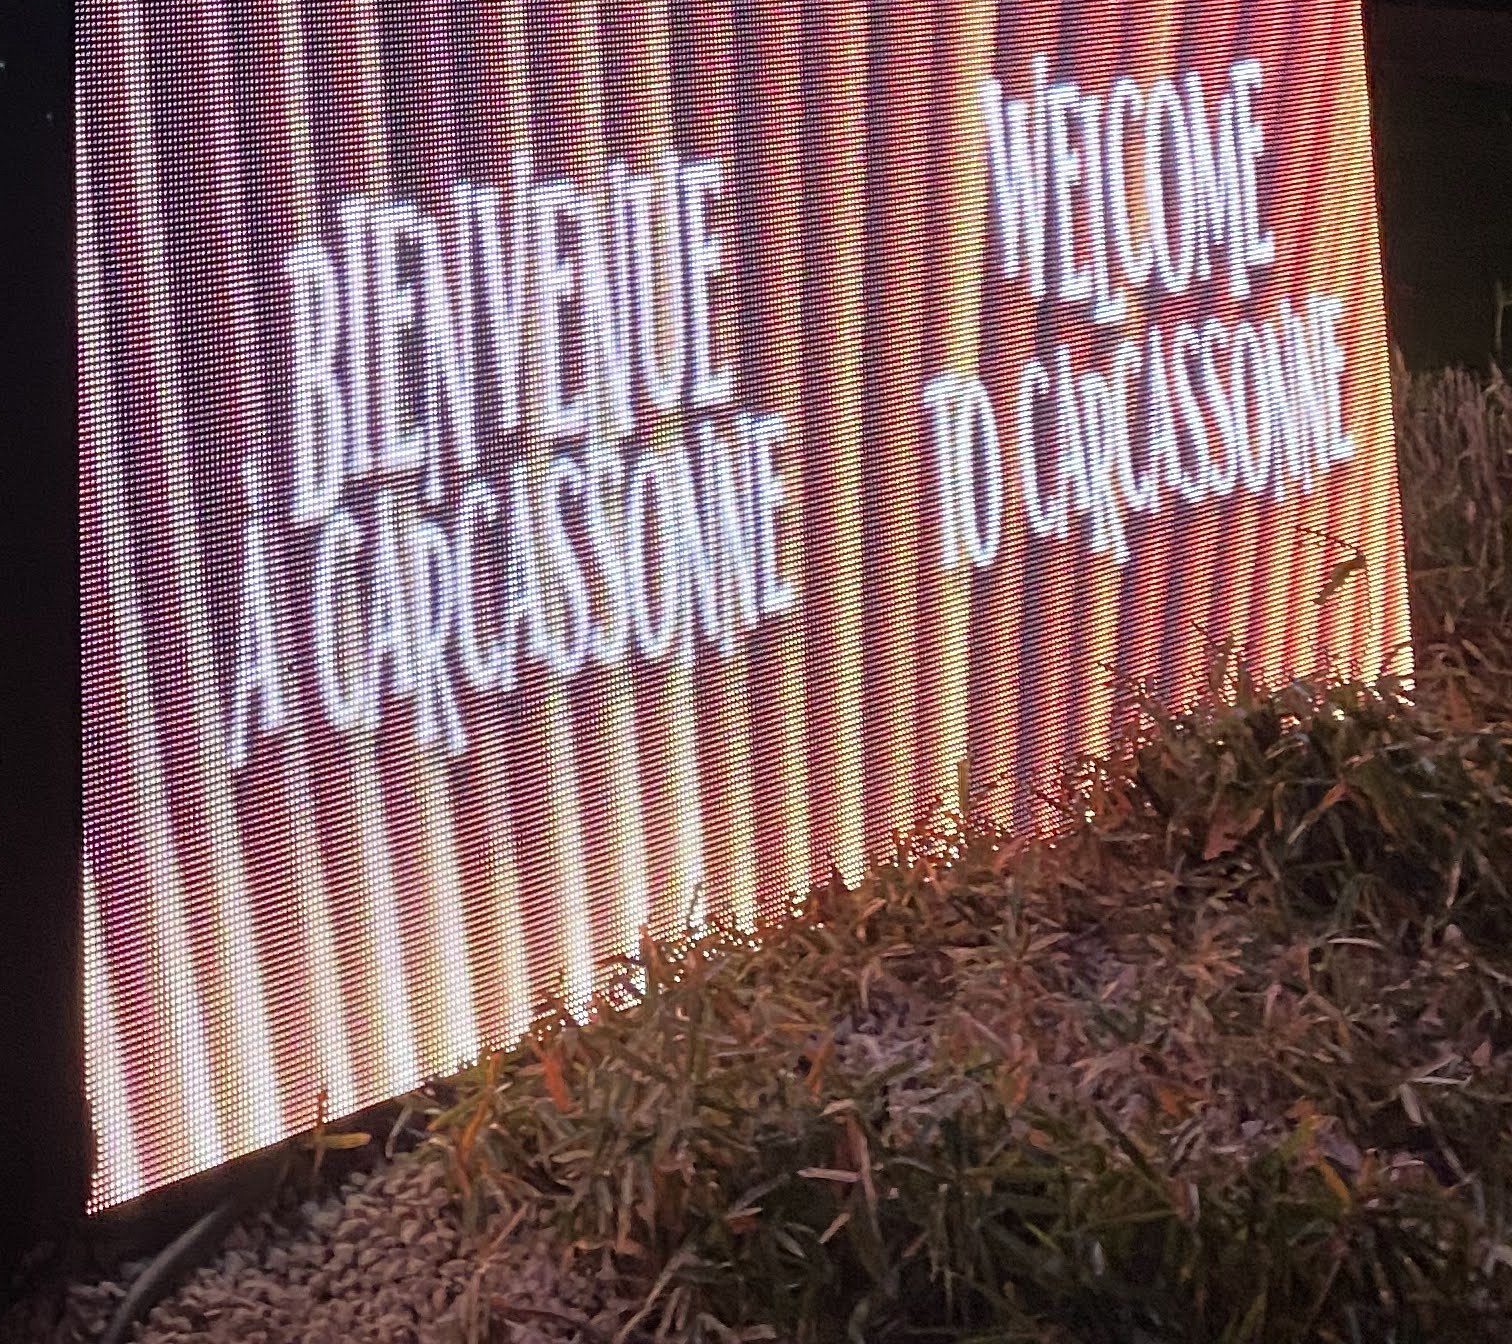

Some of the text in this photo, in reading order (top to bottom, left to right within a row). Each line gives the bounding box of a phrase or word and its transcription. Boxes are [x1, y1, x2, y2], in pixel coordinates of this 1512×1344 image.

[284, 149, 734, 526] BIENVENUE
[982, 53, 1275, 322] WELCOME
[924, 292, 1356, 569] TO CARCASSONNE
[313, 414, 796, 758] CARCASSONNE
